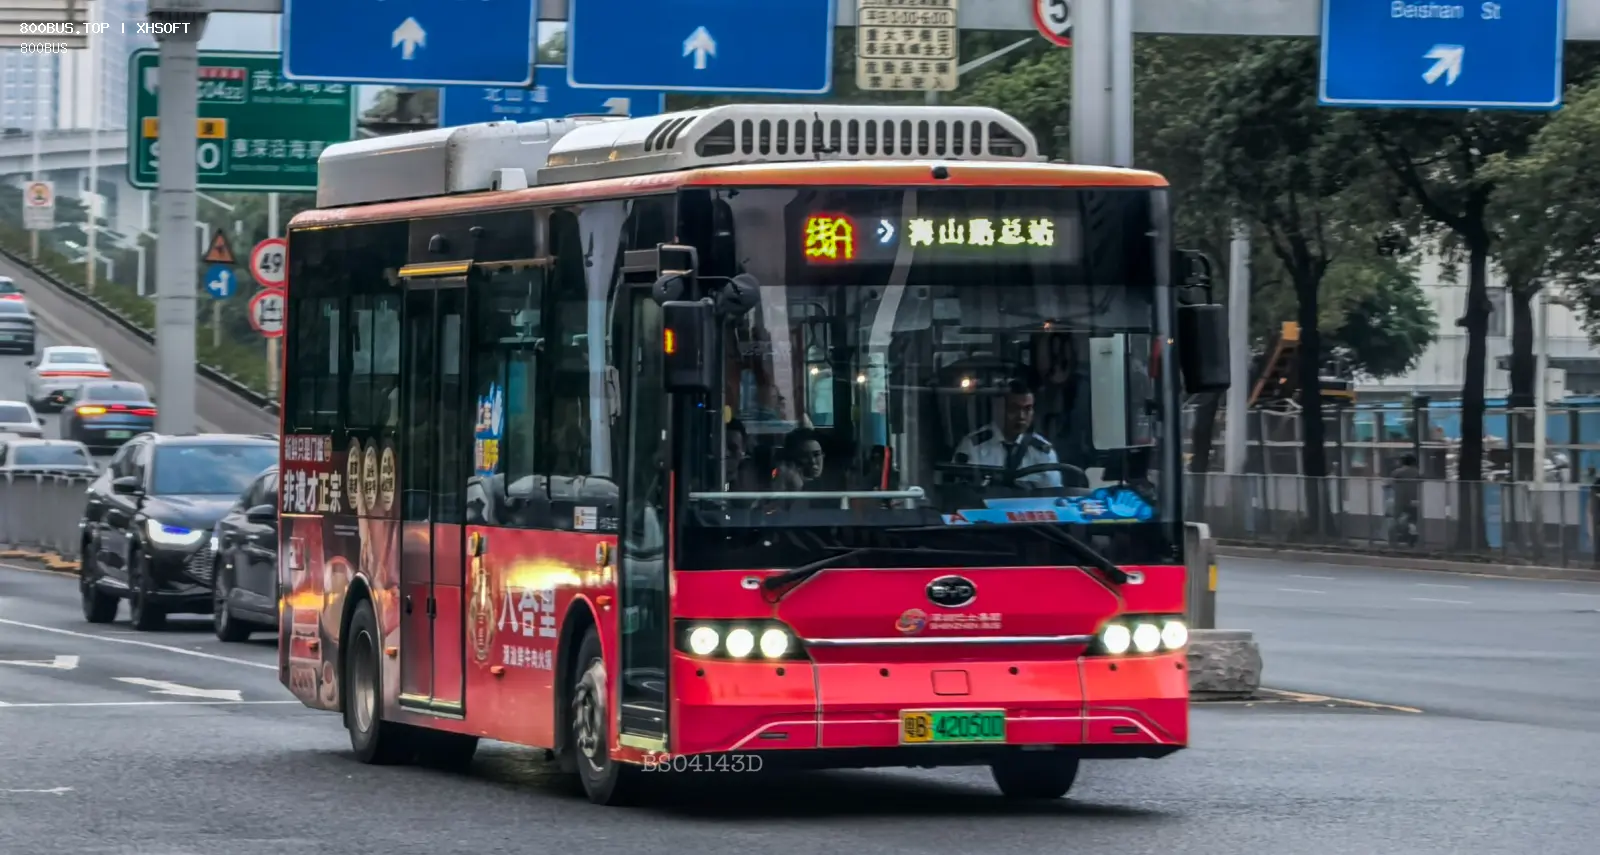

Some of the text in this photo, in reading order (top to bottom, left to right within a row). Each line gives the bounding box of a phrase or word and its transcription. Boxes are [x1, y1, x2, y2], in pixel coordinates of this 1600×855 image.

[1049, 0, 1069, 24] 5
[1390, 1, 1501, 19] Beishan St
[149, 142, 220, 169] S0
[908, 218, 1055, 246] 海山路总站
[283, 469, 342, 513] 非遗才正宗
[931, 585, 972, 598] BYD
[498, 583, 557, 638] 八合里
[904, 715, 926, 738] 粤B
